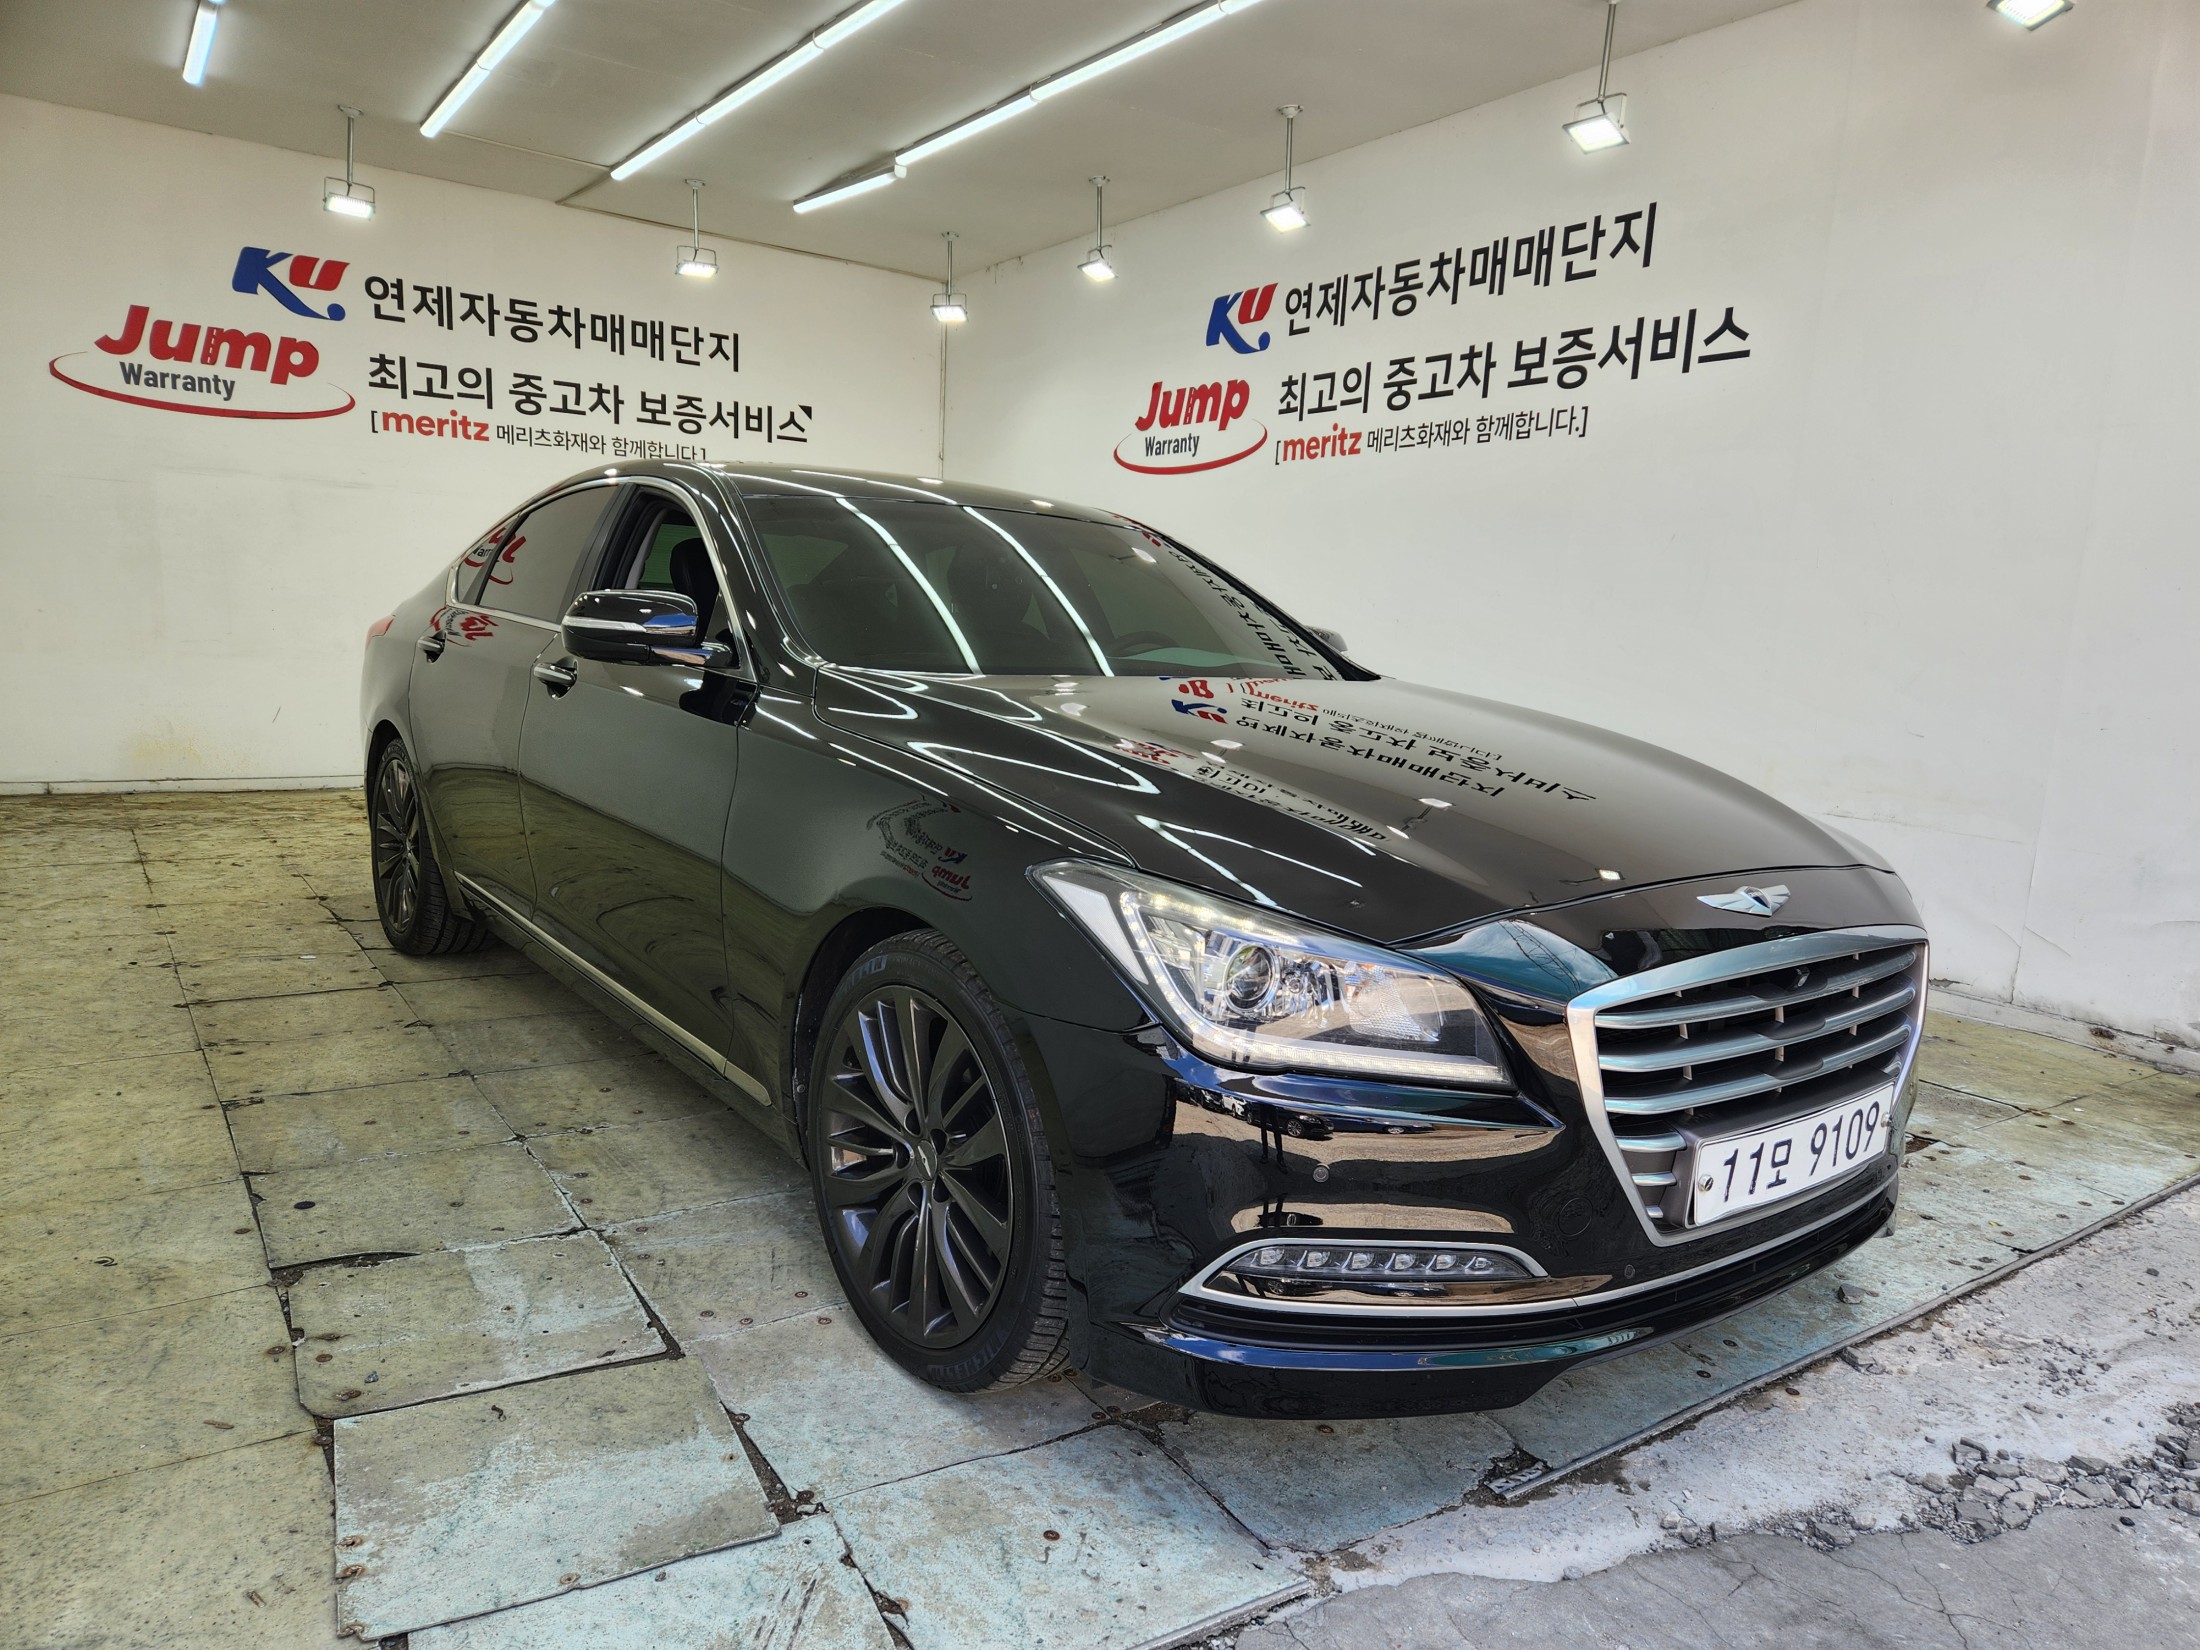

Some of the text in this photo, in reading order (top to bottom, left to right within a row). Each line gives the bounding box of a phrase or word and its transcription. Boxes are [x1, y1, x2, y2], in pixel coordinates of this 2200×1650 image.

[1286, 202, 1657, 336] 연제자동차매매단지
[95, 305, 320, 386] Jump
[365, 276, 738, 372] 연제자동차매매단지
[1278, 307, 1750, 422] 최고의 중고차 보증서비스
[120, 361, 236, 402] Warranty
[368, 354, 812, 443] 최고의 중고차 보증서비스
[1135, 380, 1250, 431] Jump
[497, 425, 607, 455] 메리츠화재와
[1145, 433, 1200, 457] Warranty
[1367, 418, 1471, 453] 메리츠화재와
[1477, 406, 1589, 443] 함께합니다.]
[1723, 1101, 1880, 1202] 11모 9109
